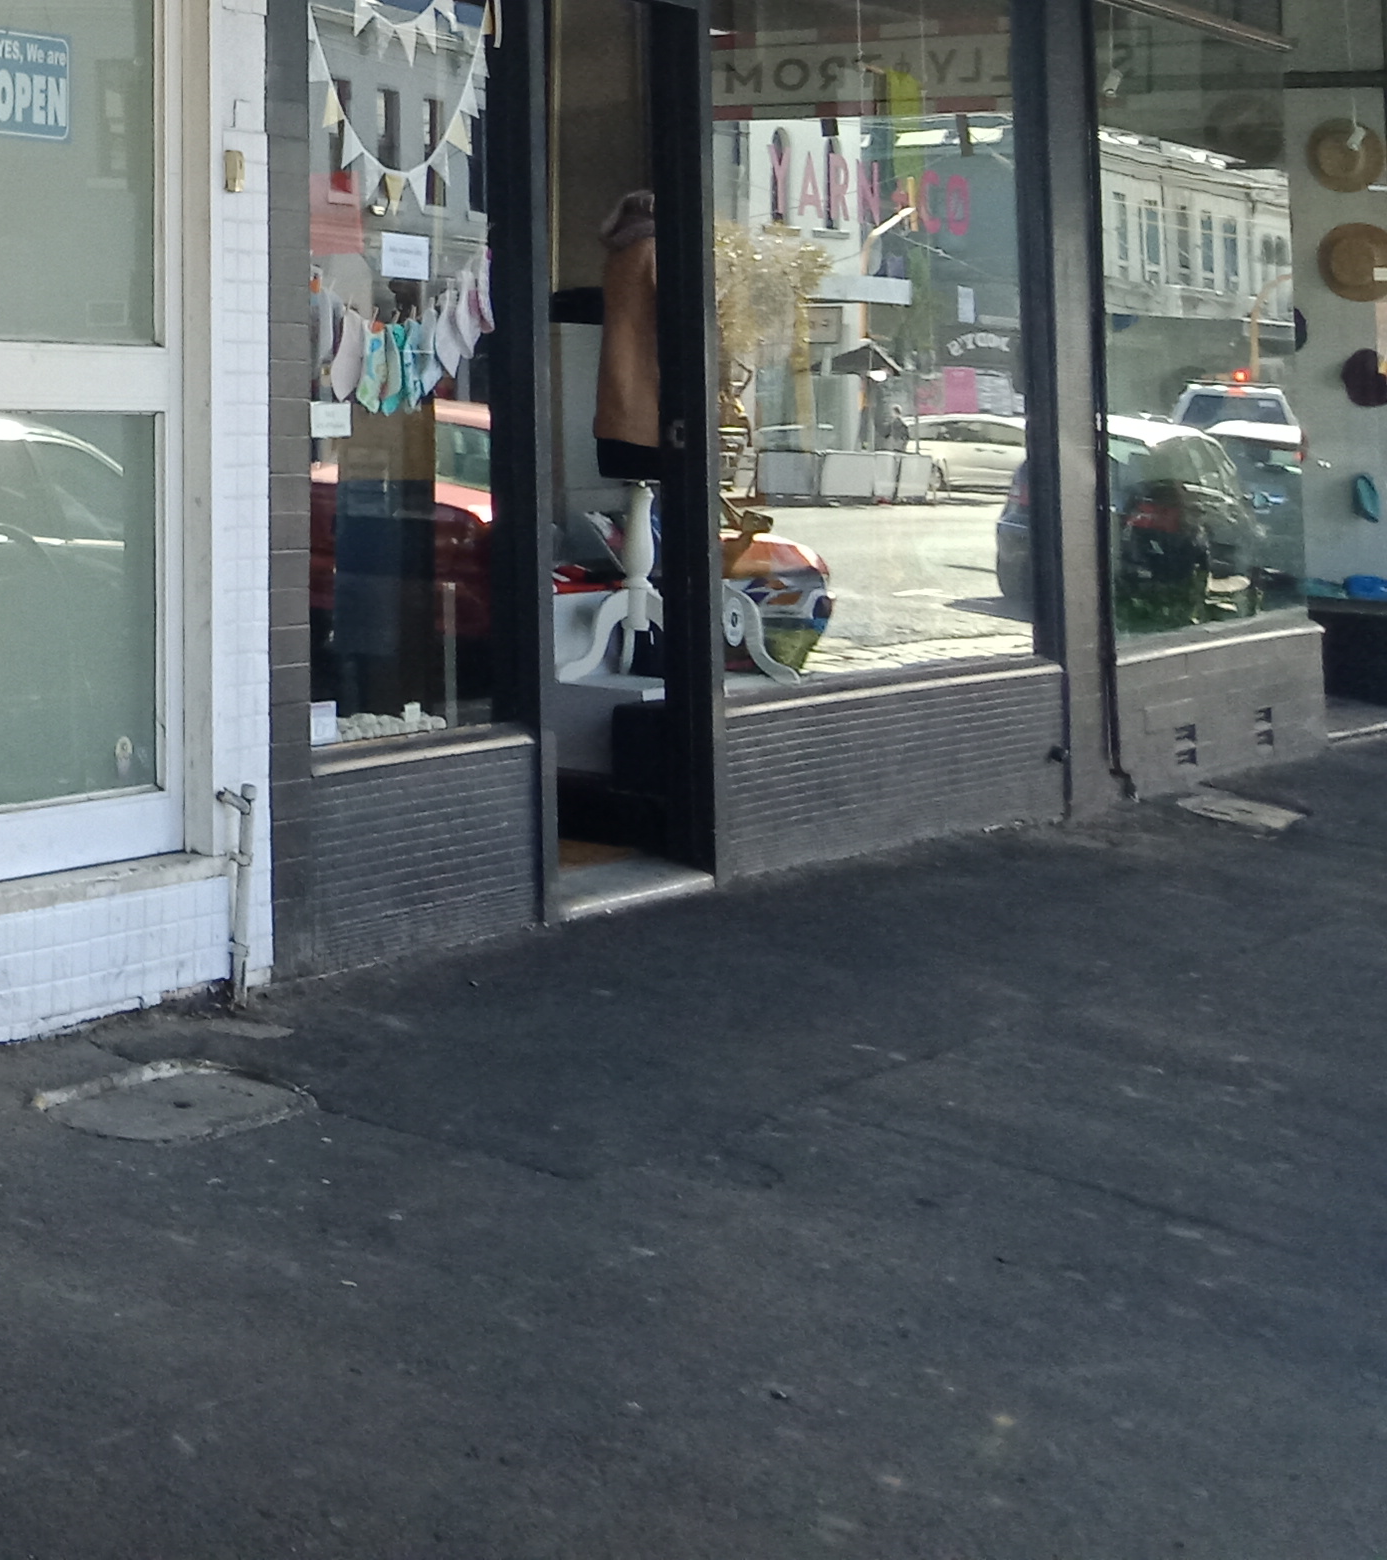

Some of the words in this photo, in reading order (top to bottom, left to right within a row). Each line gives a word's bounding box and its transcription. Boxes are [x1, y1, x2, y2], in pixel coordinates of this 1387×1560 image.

[26, 42, 46, 64] We
[47, 50, 68, 68] are
[767, 138, 882, 228] YARN
